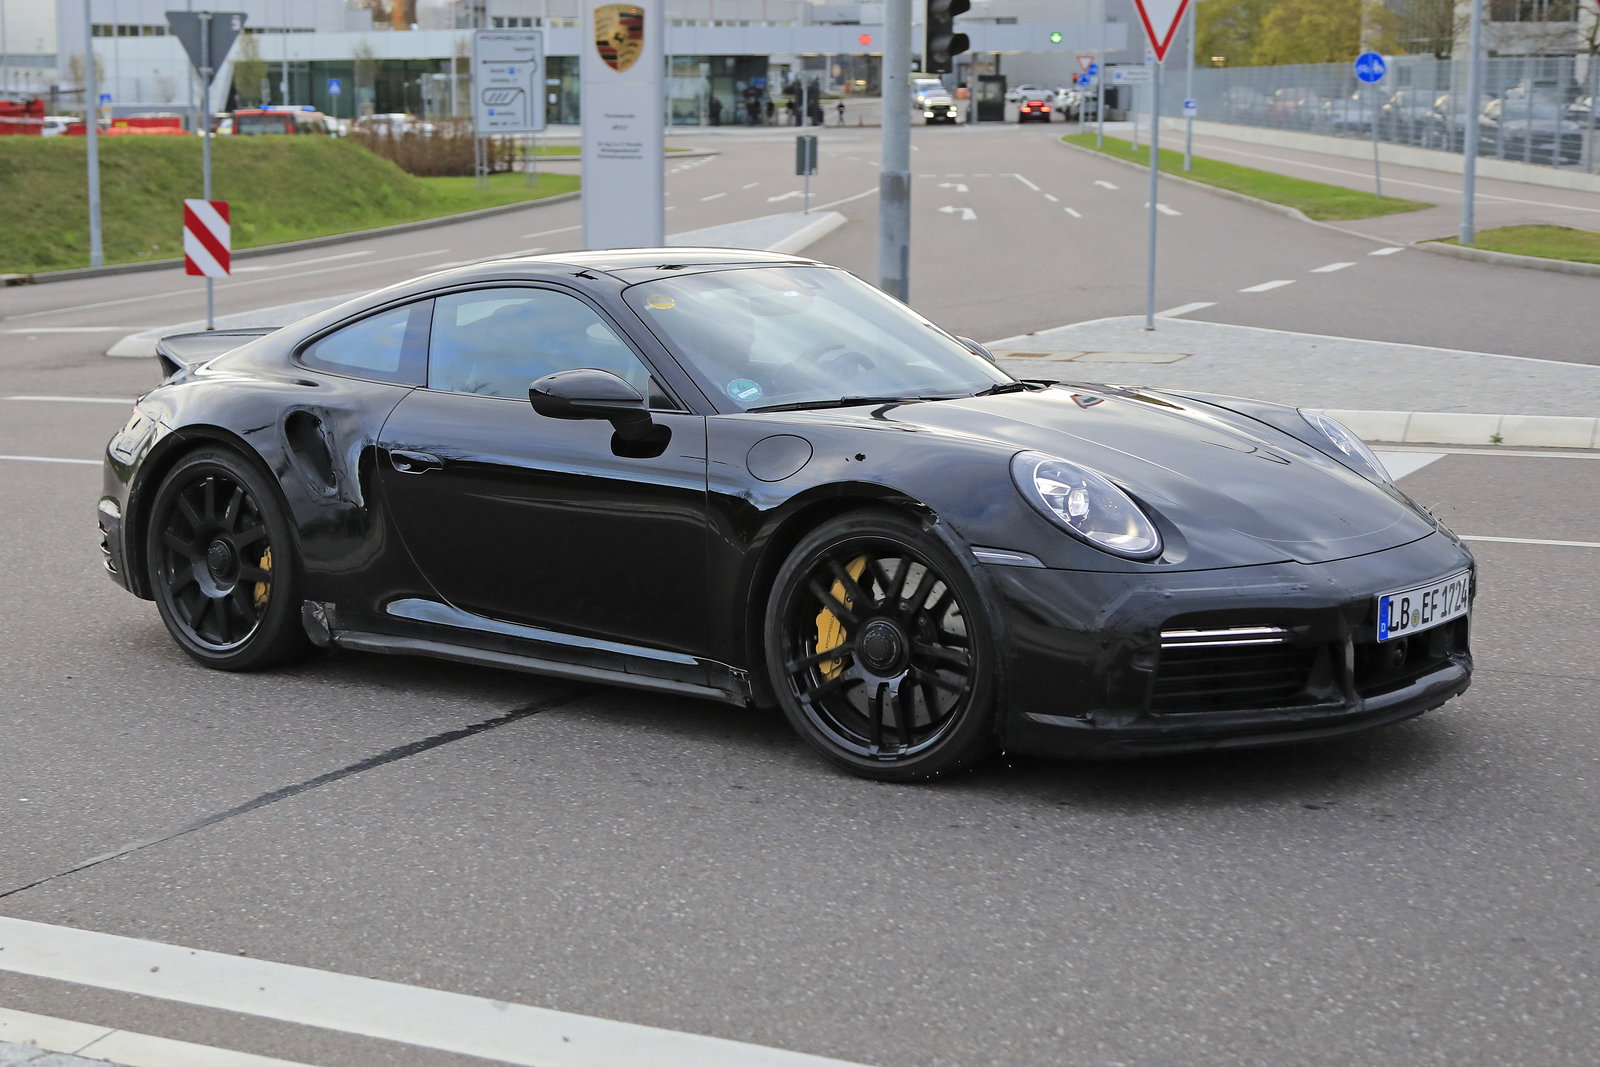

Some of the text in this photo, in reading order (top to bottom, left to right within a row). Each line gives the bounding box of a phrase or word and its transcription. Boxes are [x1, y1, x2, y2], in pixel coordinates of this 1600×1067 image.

[1388, 578, 1467, 632] LB EF 1724
[825, 615, 835, 649] PORSC
[1381, 622, 1386, 633] D
